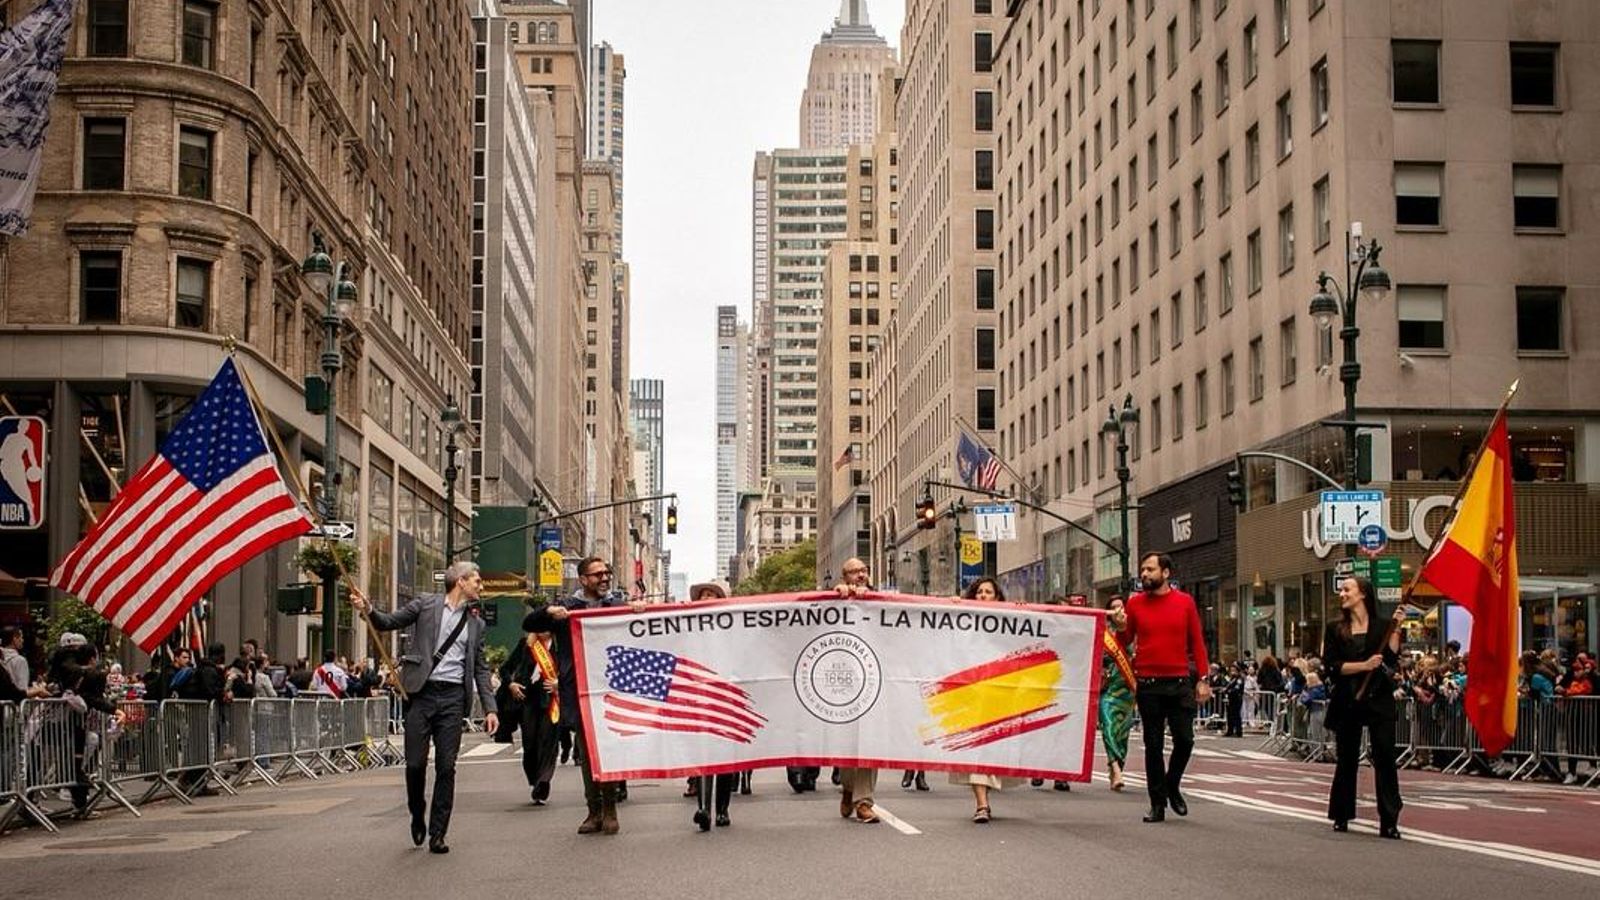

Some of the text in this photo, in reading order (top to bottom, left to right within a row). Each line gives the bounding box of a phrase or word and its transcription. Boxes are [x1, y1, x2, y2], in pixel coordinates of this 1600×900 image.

[1, 503, 24, 522] NBA
[1171, 513, 1192, 543] VANS
[629, 612, 734, 637] CENTRO
[743, 603, 855, 628] ESPAÑOL
[880, 609, 911, 628] LA
[920, 611, 1049, 638] NACIONAL
[807, 636, 869, 660] LA NACIONAL
